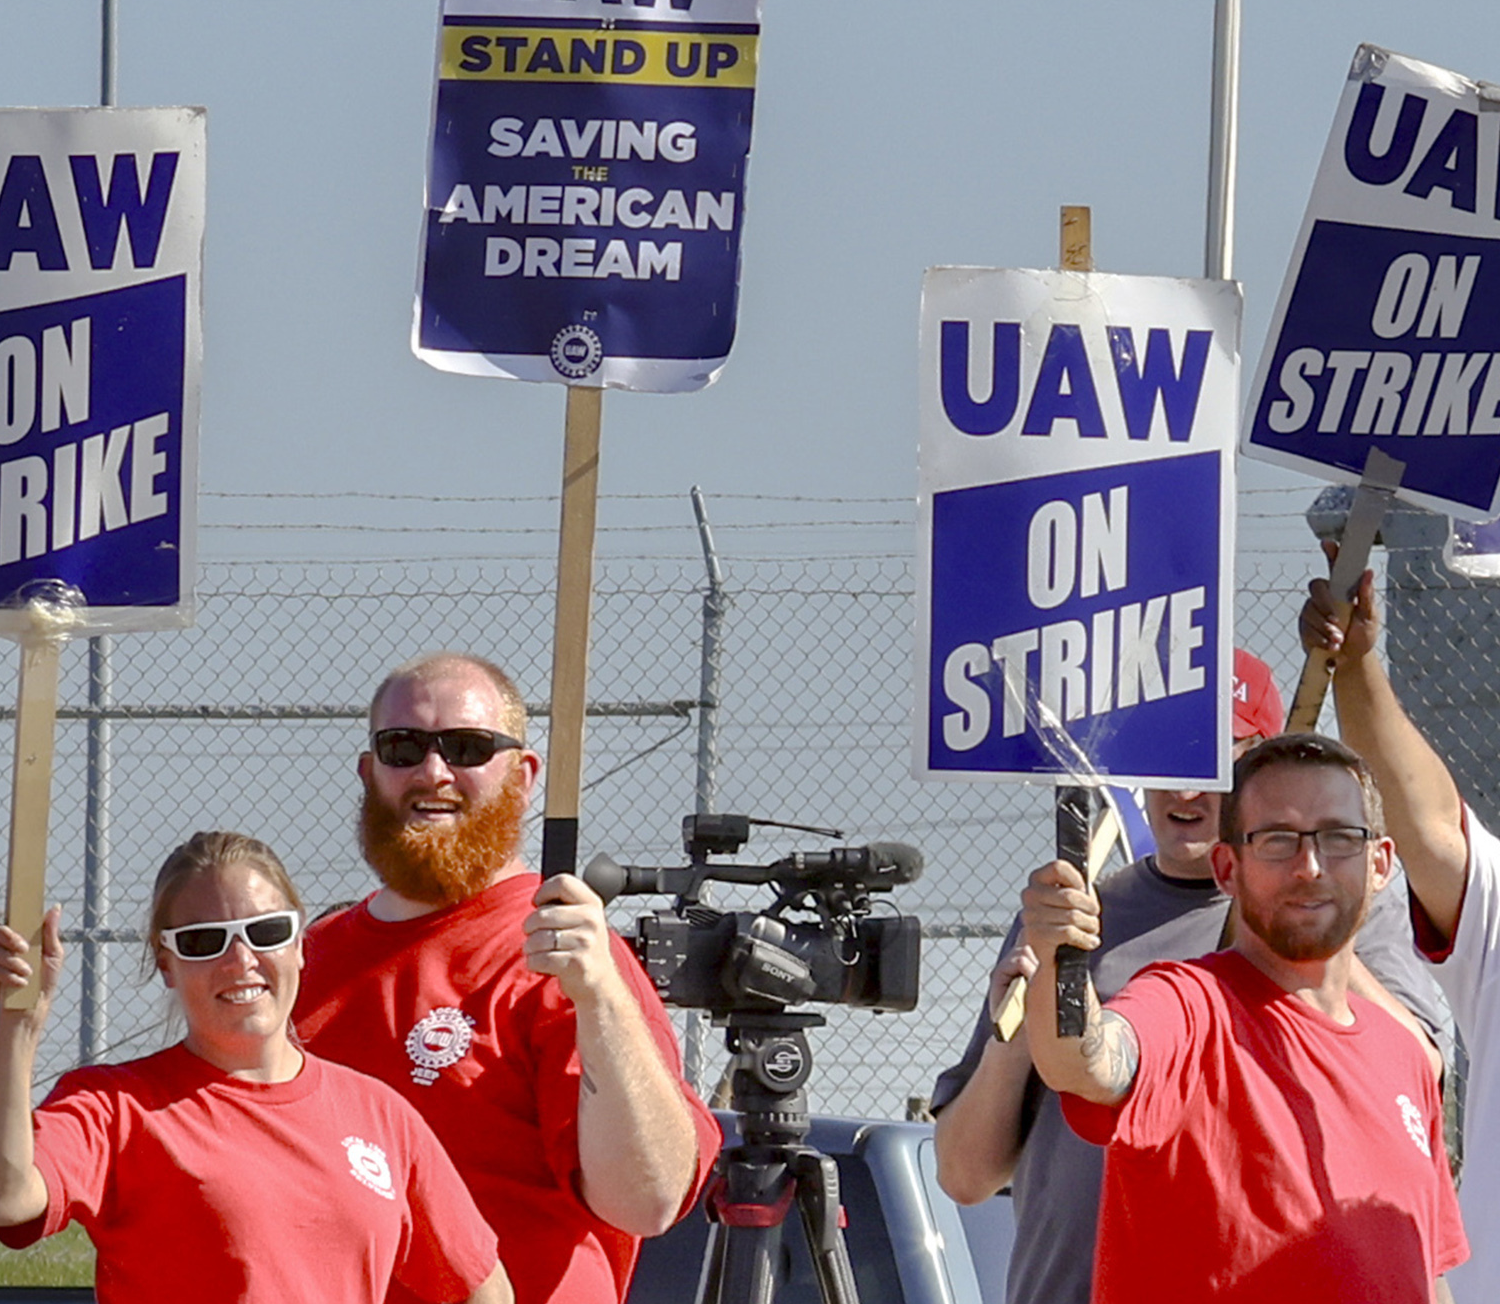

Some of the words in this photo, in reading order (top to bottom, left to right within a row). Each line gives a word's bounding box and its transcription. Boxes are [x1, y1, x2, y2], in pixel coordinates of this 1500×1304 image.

[459, 36, 646, 74] STAND
[665, 42, 739, 78] UP
[487, 118, 696, 162] SAVING
[572, 166, 608, 182] THE
[438, 185, 735, 230] AMERICAN
[484, 238, 681, 280] DREAM
[1371, 252, 1480, 340] ON
[939, 321, 1213, 441] UAW
[1027, 485, 1128, 609] ON
[942, 585, 1206, 751] STRIKE
[761, 961, 795, 983] SONY
